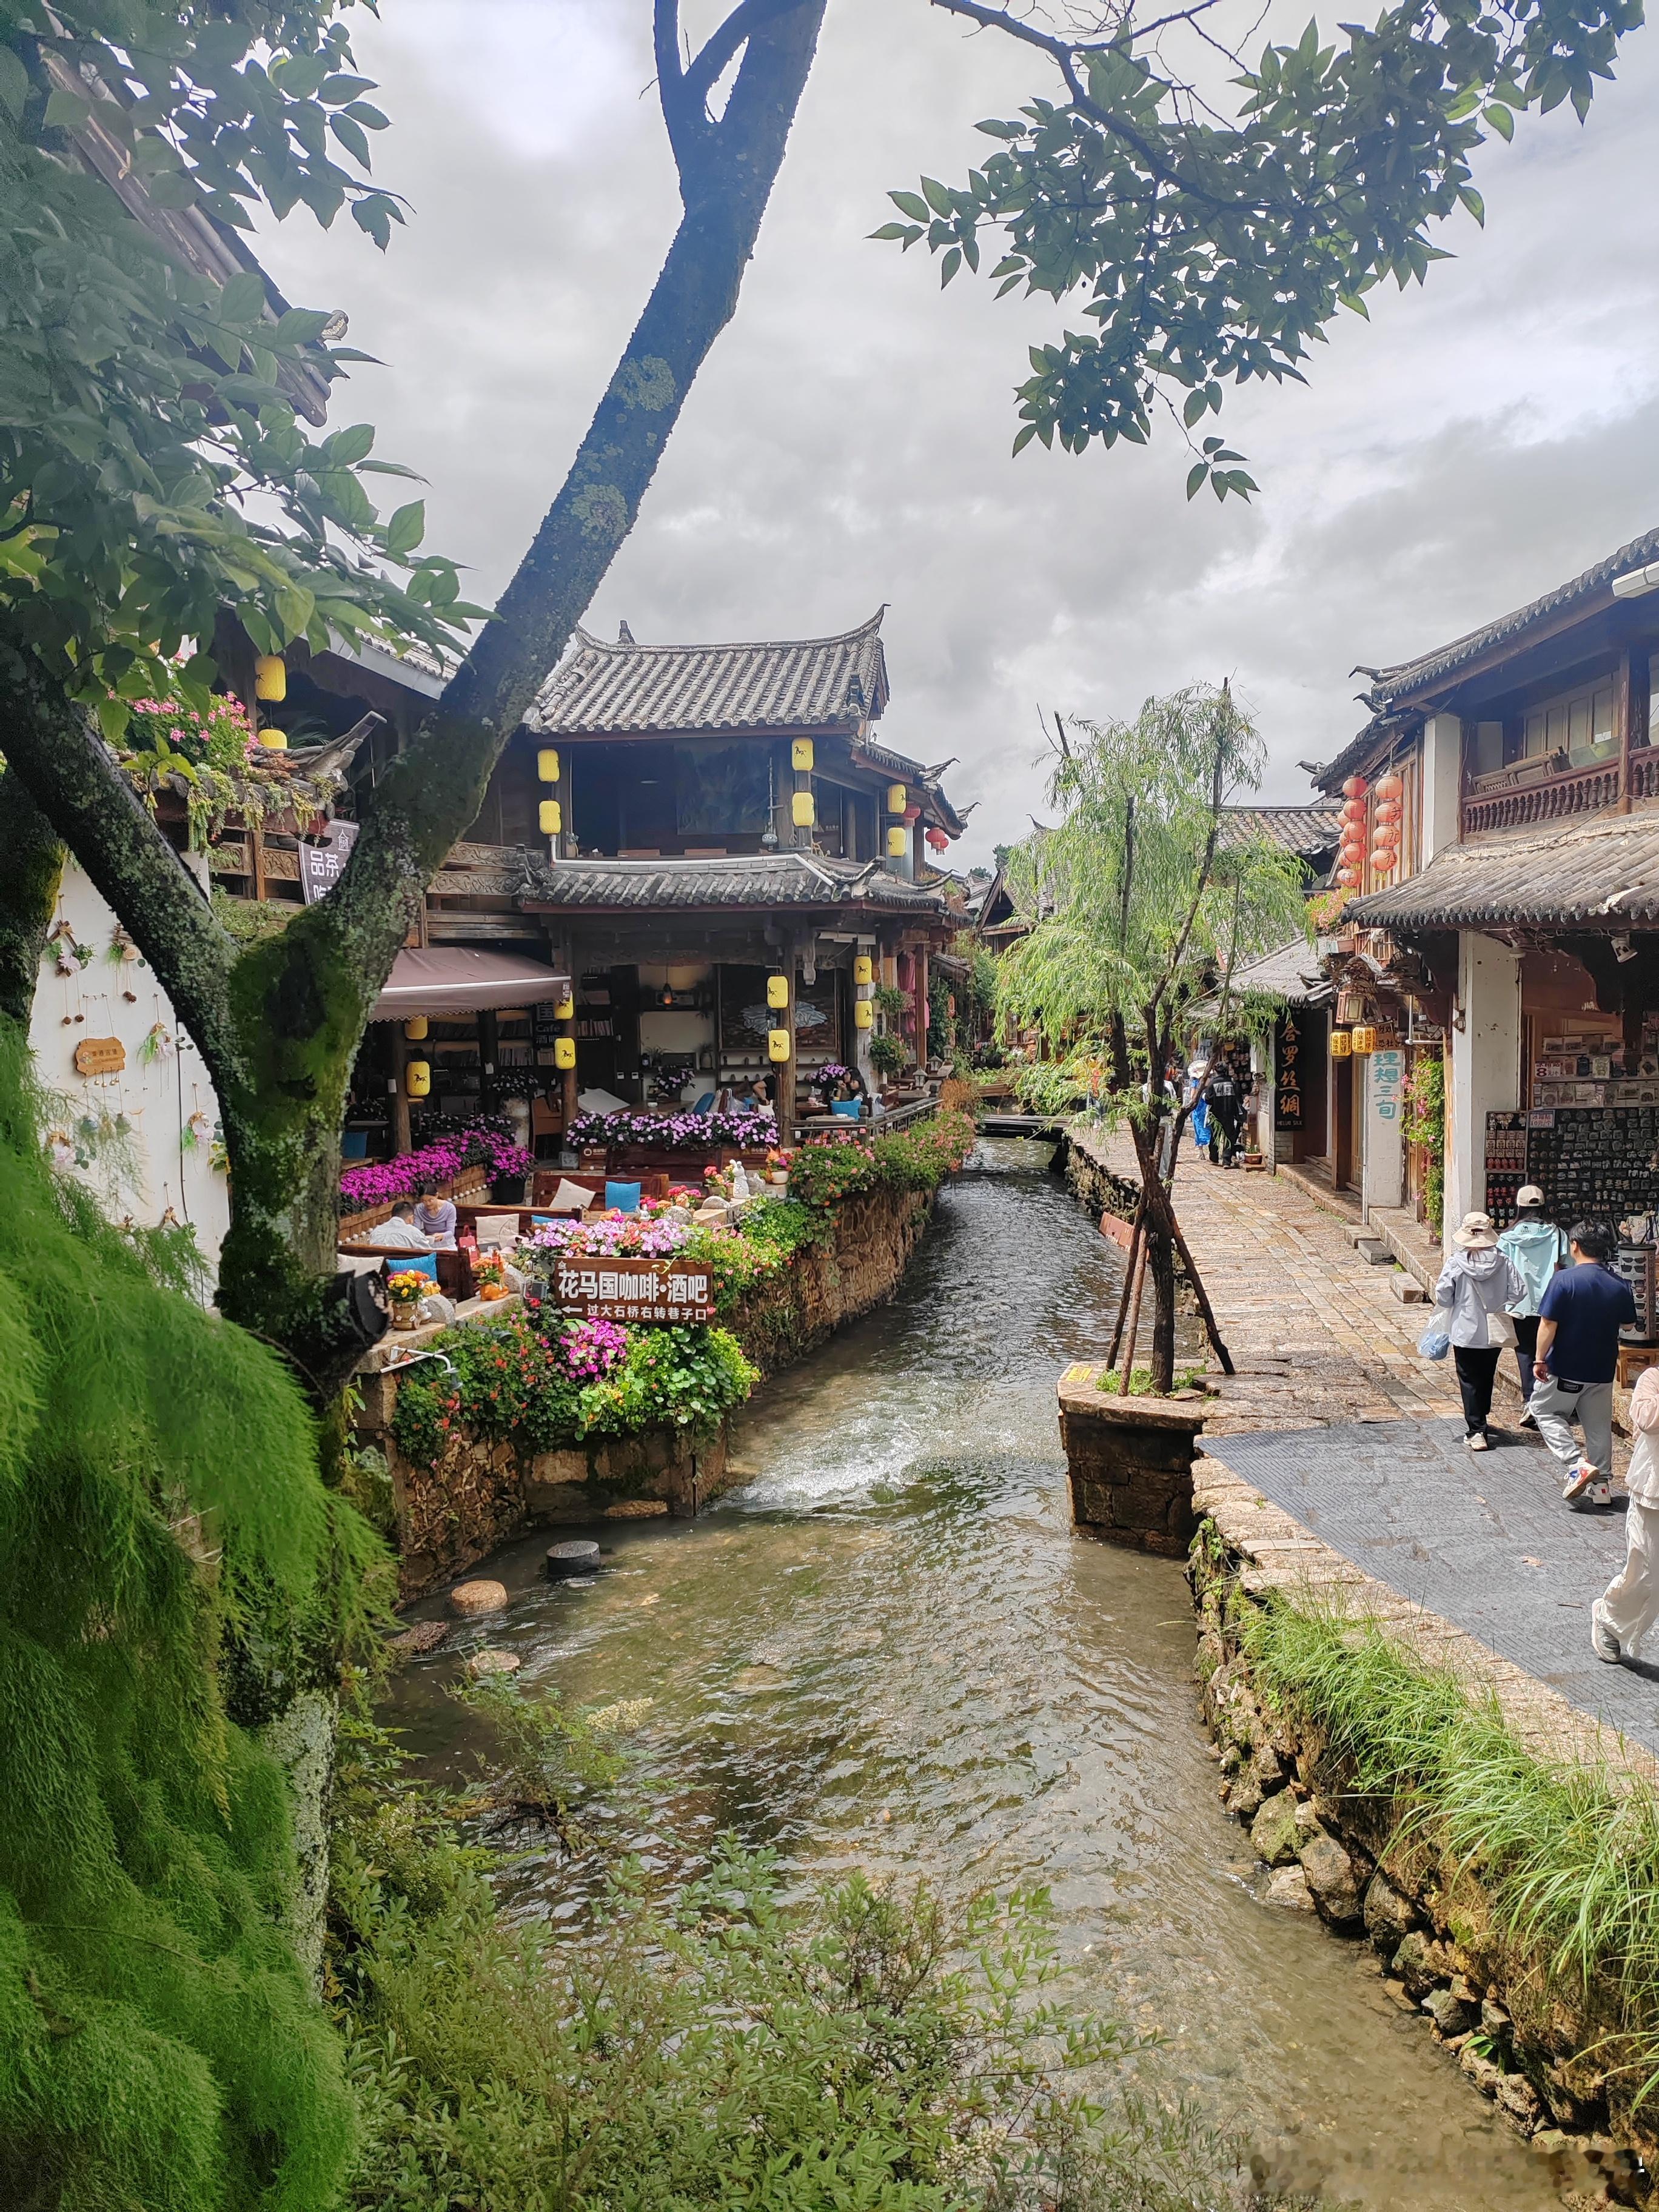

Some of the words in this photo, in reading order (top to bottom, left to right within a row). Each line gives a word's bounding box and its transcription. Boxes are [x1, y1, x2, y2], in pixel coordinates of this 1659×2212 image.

[558, 1269, 709, 1304] 花马国咖啡·酒吧
[587, 1304, 707, 1321] 过大石桥右转巷子口
